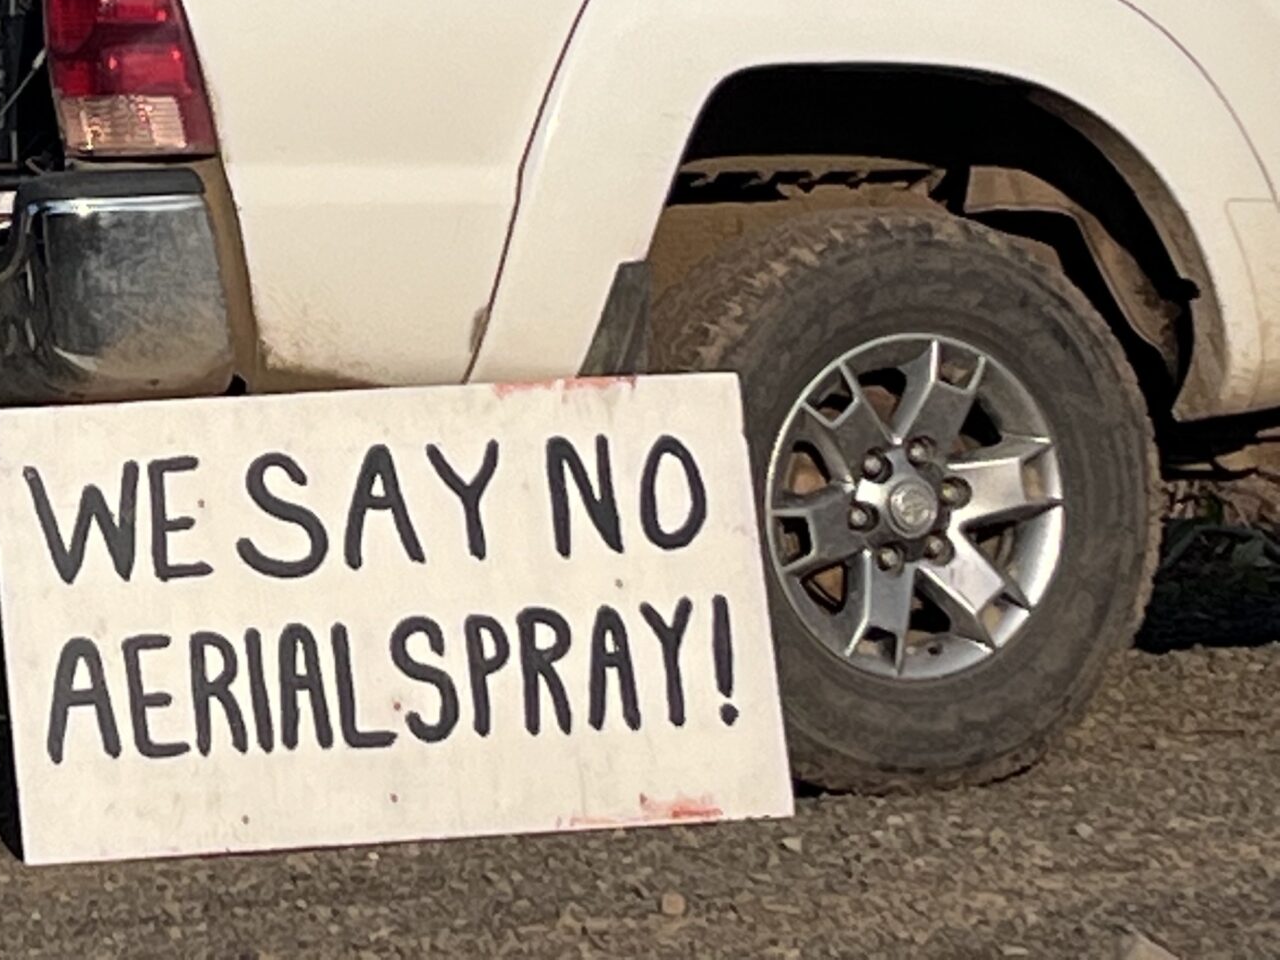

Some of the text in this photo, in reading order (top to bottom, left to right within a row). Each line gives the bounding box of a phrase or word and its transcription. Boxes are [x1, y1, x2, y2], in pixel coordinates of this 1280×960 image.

[23, 433, 708, 583] WE SAY NO
[46, 593, 740, 764] AERIAL SPRAY!
